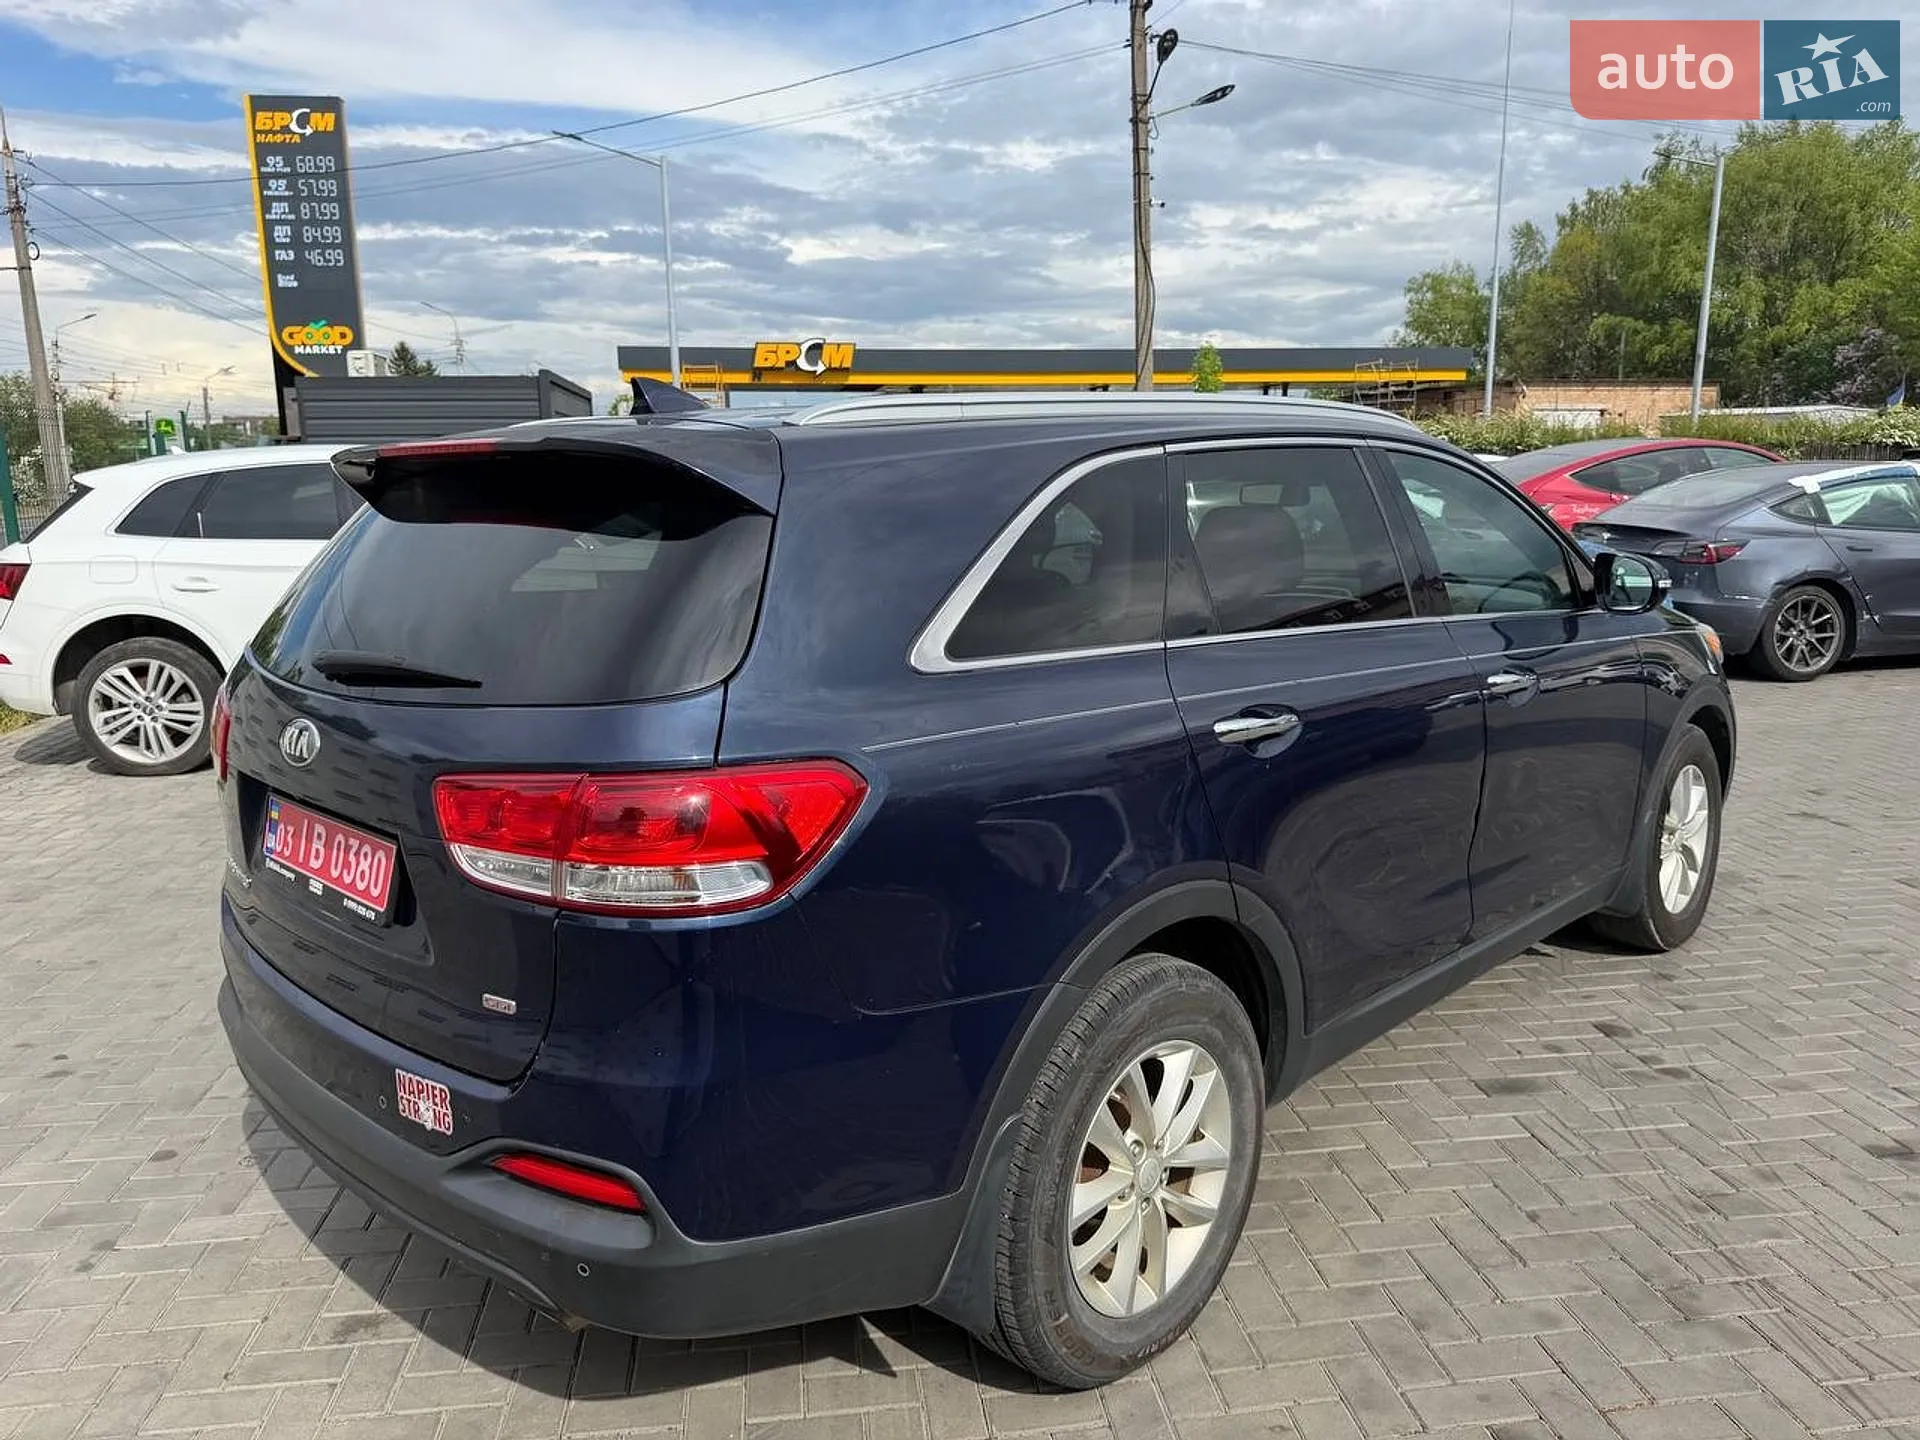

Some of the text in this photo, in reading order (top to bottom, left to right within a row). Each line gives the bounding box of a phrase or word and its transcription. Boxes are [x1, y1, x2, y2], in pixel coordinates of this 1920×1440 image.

[255, 108, 336, 136] БРСМ
[256, 133, 302, 143] НАФТА
[266, 156, 335, 173] 95 68.99
[268, 179, 288, 191] 95
[298, 180, 338, 197] 57.99
[271, 203, 340, 220] ДП 87.99
[302, 226, 342, 243] 84.99
[275, 249, 345, 267] ГАЗ 46.99
[281, 325, 354, 346] GOOD
[294, 345, 344, 354] MARKET
[754, 338, 855, 375] БРСМ
[276, 823, 294, 857] 03
[330, 833, 387, 898] 0380
[397, 1071, 450, 1111] NAPIER
[399, 1097, 453, 1132] STRNG
